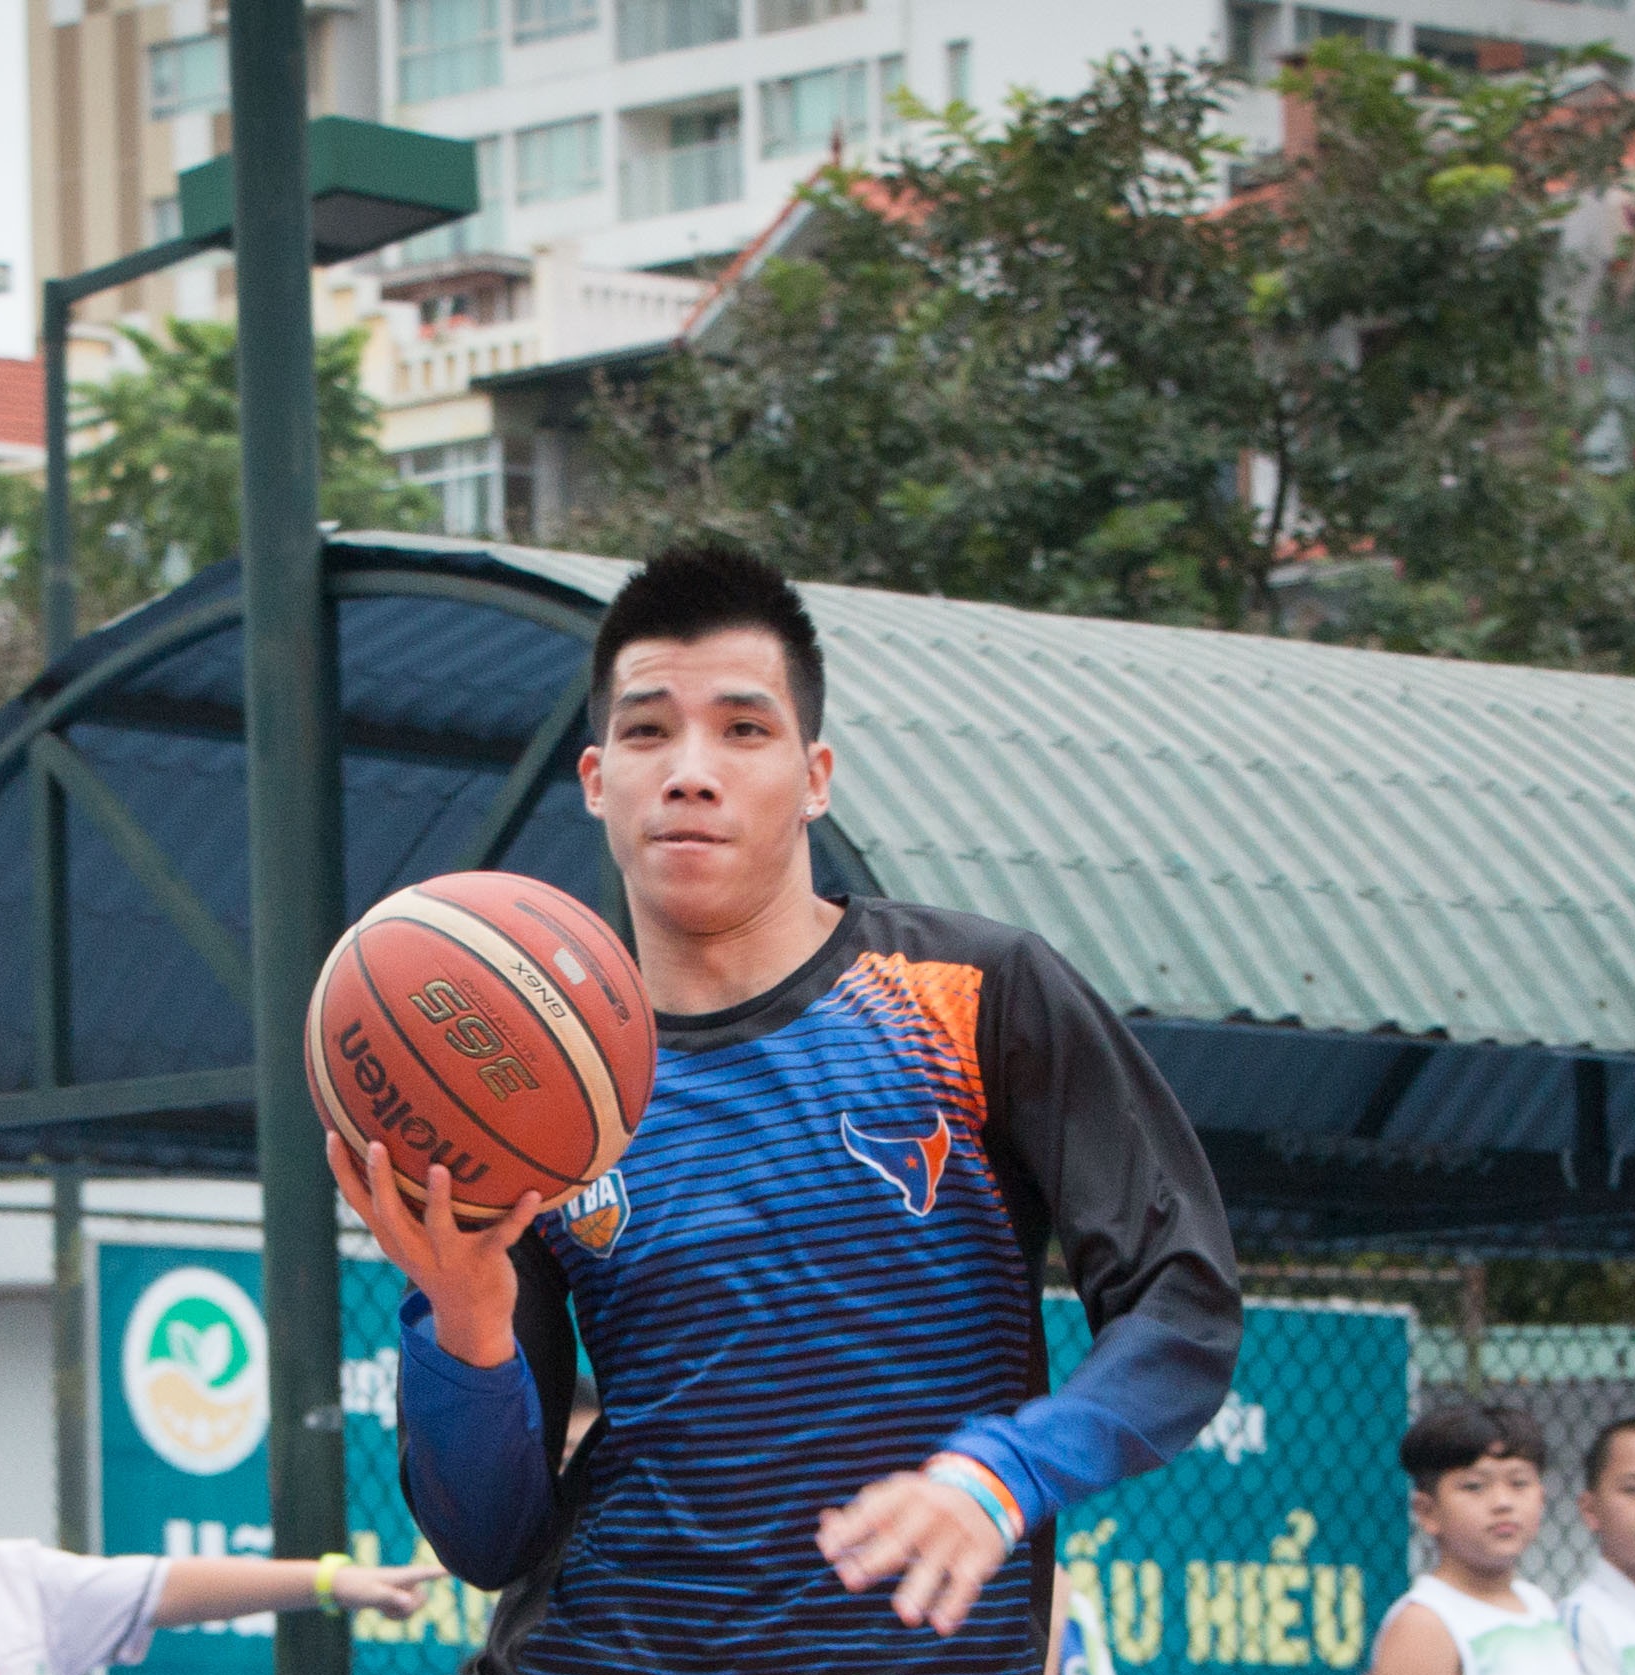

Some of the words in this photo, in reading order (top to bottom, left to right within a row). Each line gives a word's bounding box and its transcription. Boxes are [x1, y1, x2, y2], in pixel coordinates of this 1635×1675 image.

[409, 978, 540, 1103] 365
[511, 961, 567, 1020] GN6X
[337, 1018, 491, 1185] molten
[1184, 1508, 1364, 1670] HIỂU
